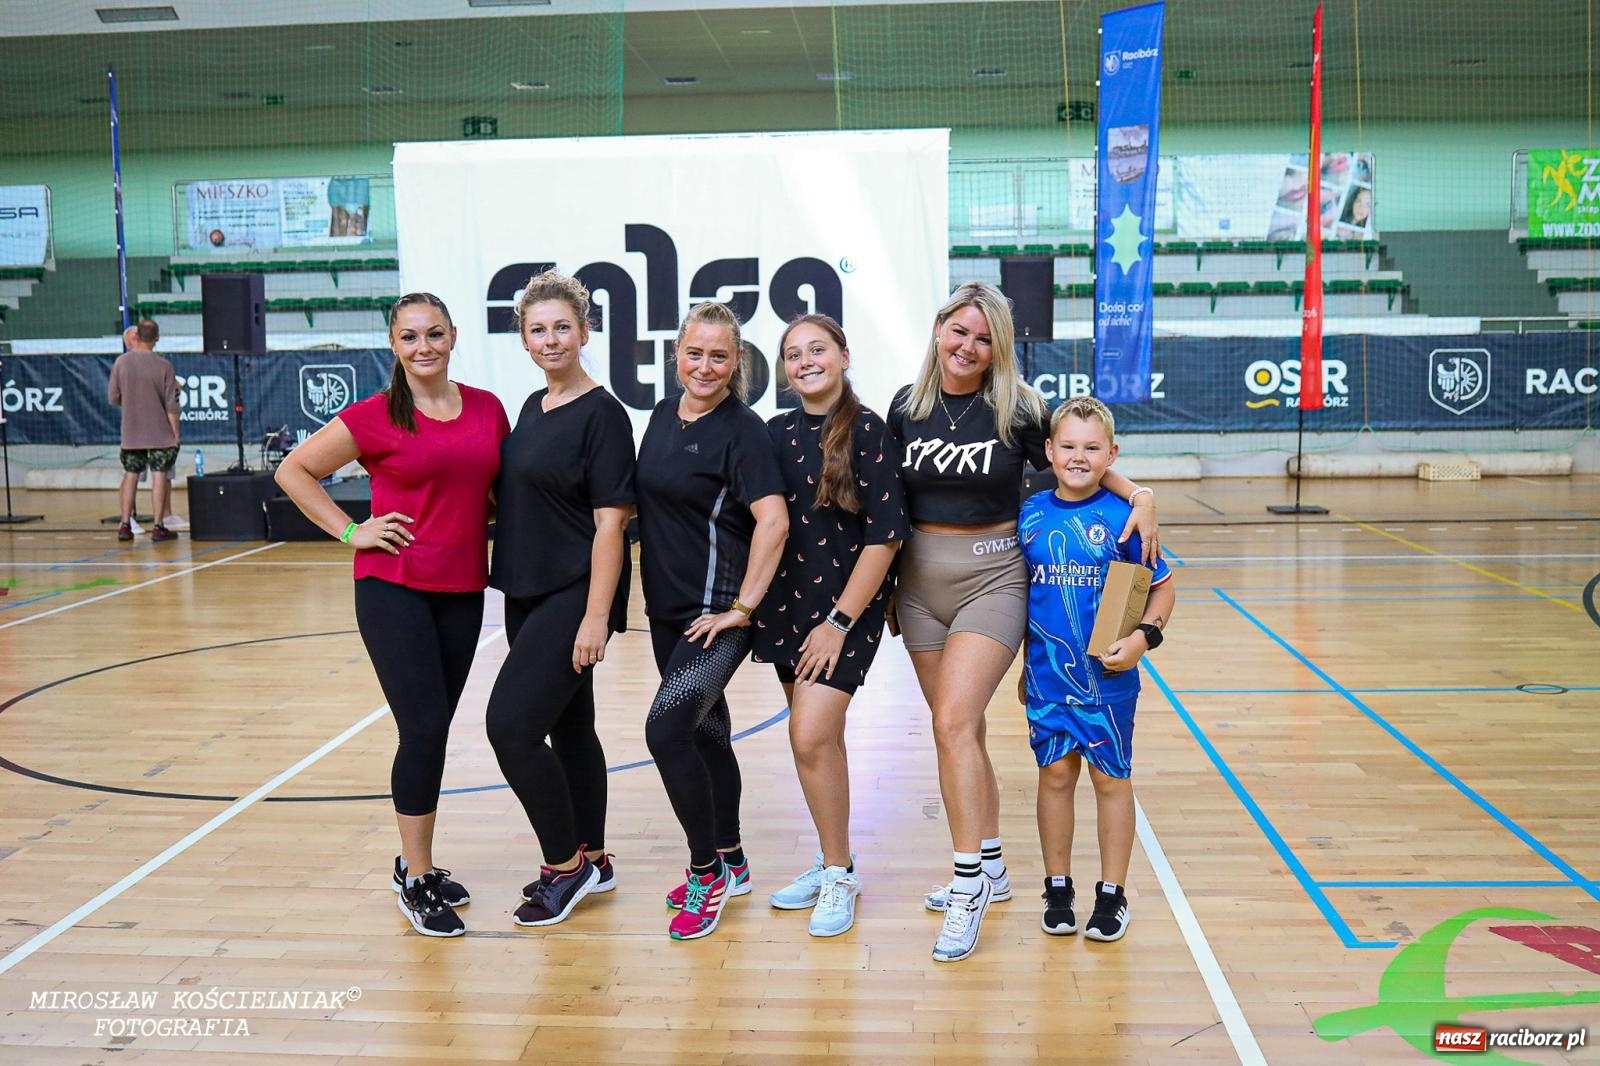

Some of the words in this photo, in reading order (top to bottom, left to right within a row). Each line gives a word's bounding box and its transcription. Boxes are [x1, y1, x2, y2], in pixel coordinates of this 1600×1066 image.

[196, 183, 269, 199] MIESZKO
[1525, 367, 1599, 395] RAC
[1, 379, 64, 412] ÓRZ
[901, 437, 999, 475] SPORT
[1048, 564, 1100, 575] INFINITE
[1048, 575, 1100, 587] ATHLETE
